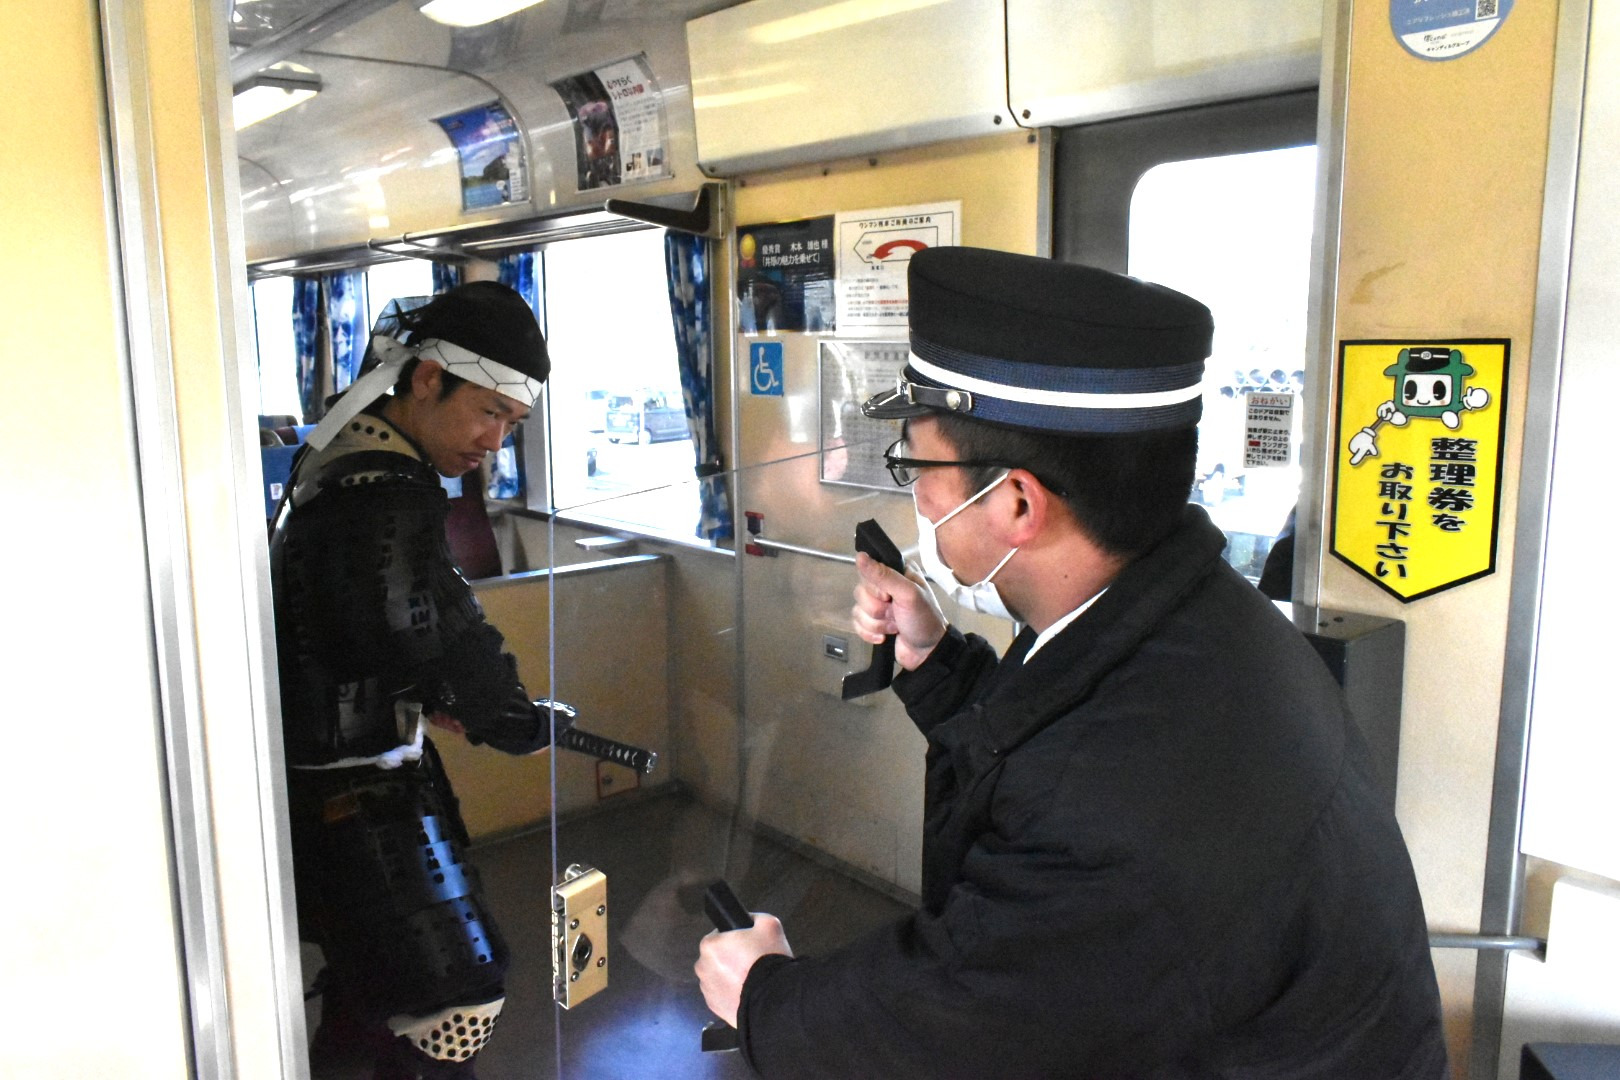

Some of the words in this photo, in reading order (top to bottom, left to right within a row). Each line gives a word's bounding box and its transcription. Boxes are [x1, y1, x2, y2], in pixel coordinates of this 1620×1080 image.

[1251, 396, 1288, 405] おねがい
[1376, 462, 1414, 578] お取り下さい
[1428, 437, 1477, 532] 整理券を
